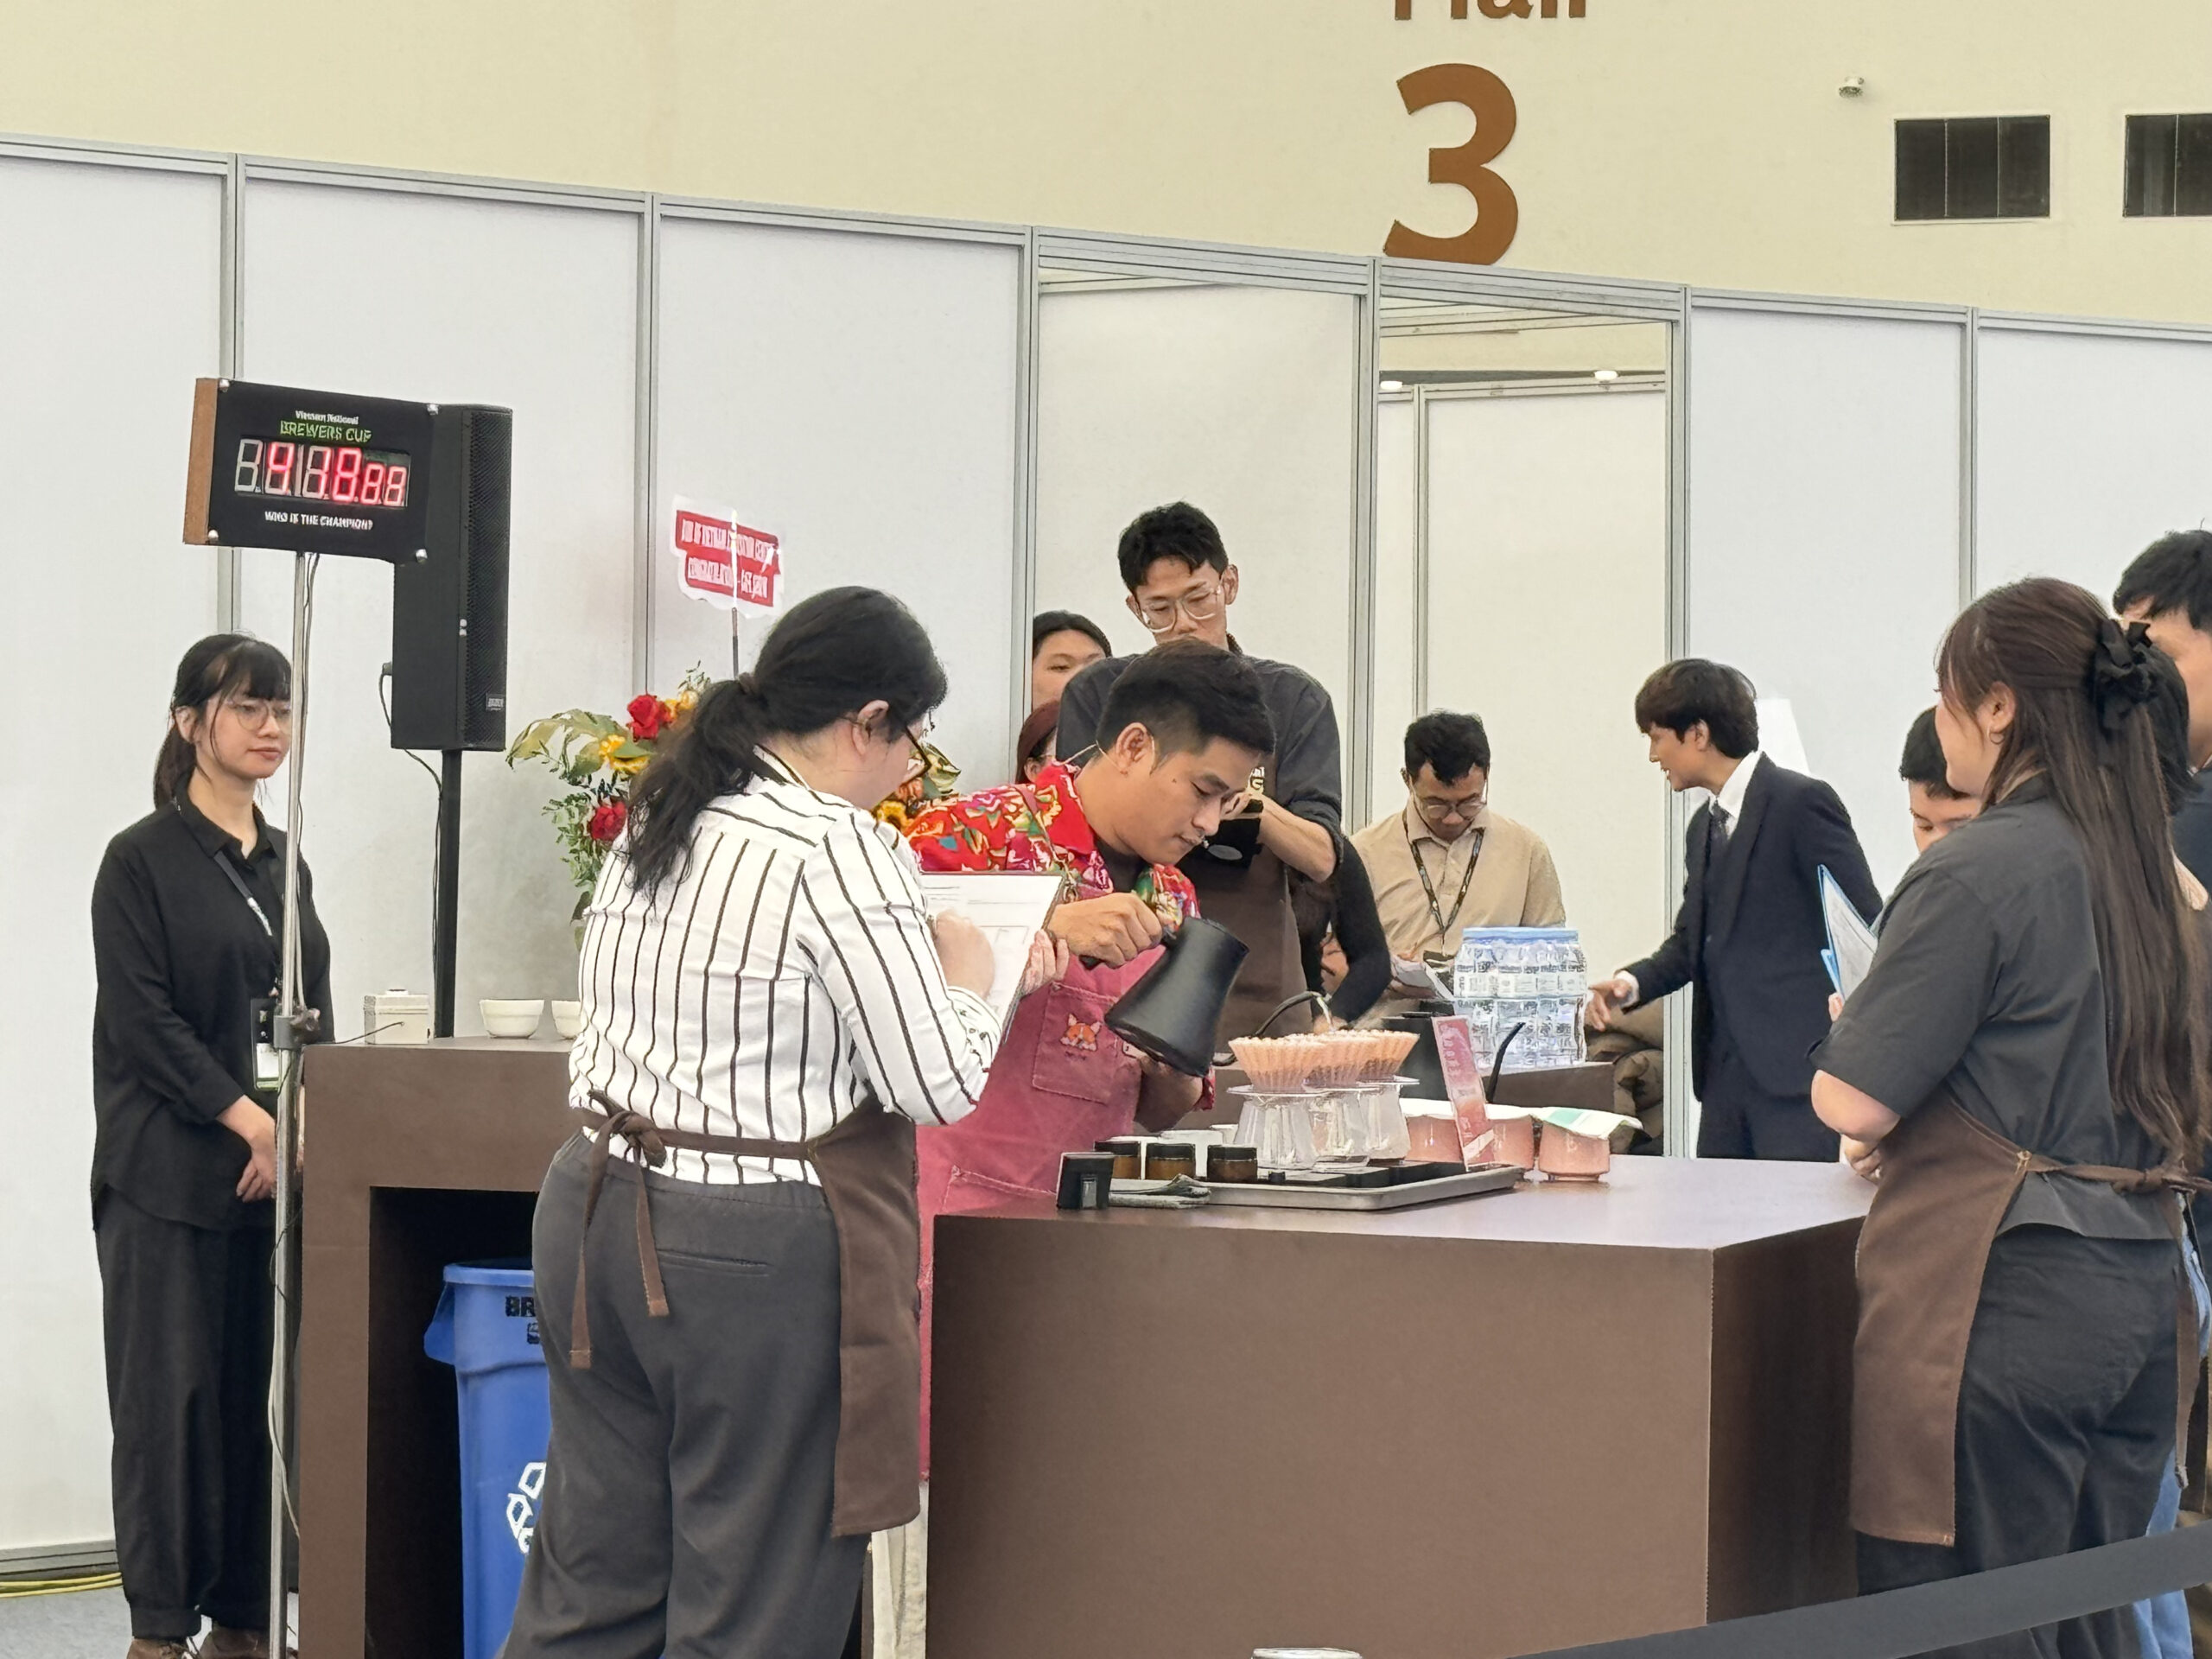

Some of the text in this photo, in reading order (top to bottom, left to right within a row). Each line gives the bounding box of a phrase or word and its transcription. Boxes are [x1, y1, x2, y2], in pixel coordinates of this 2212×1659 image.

[1383, 63, 1519, 266] 3
[280, 420, 372, 442] BREWERS CUP
[301, 513, 319, 525] THE
